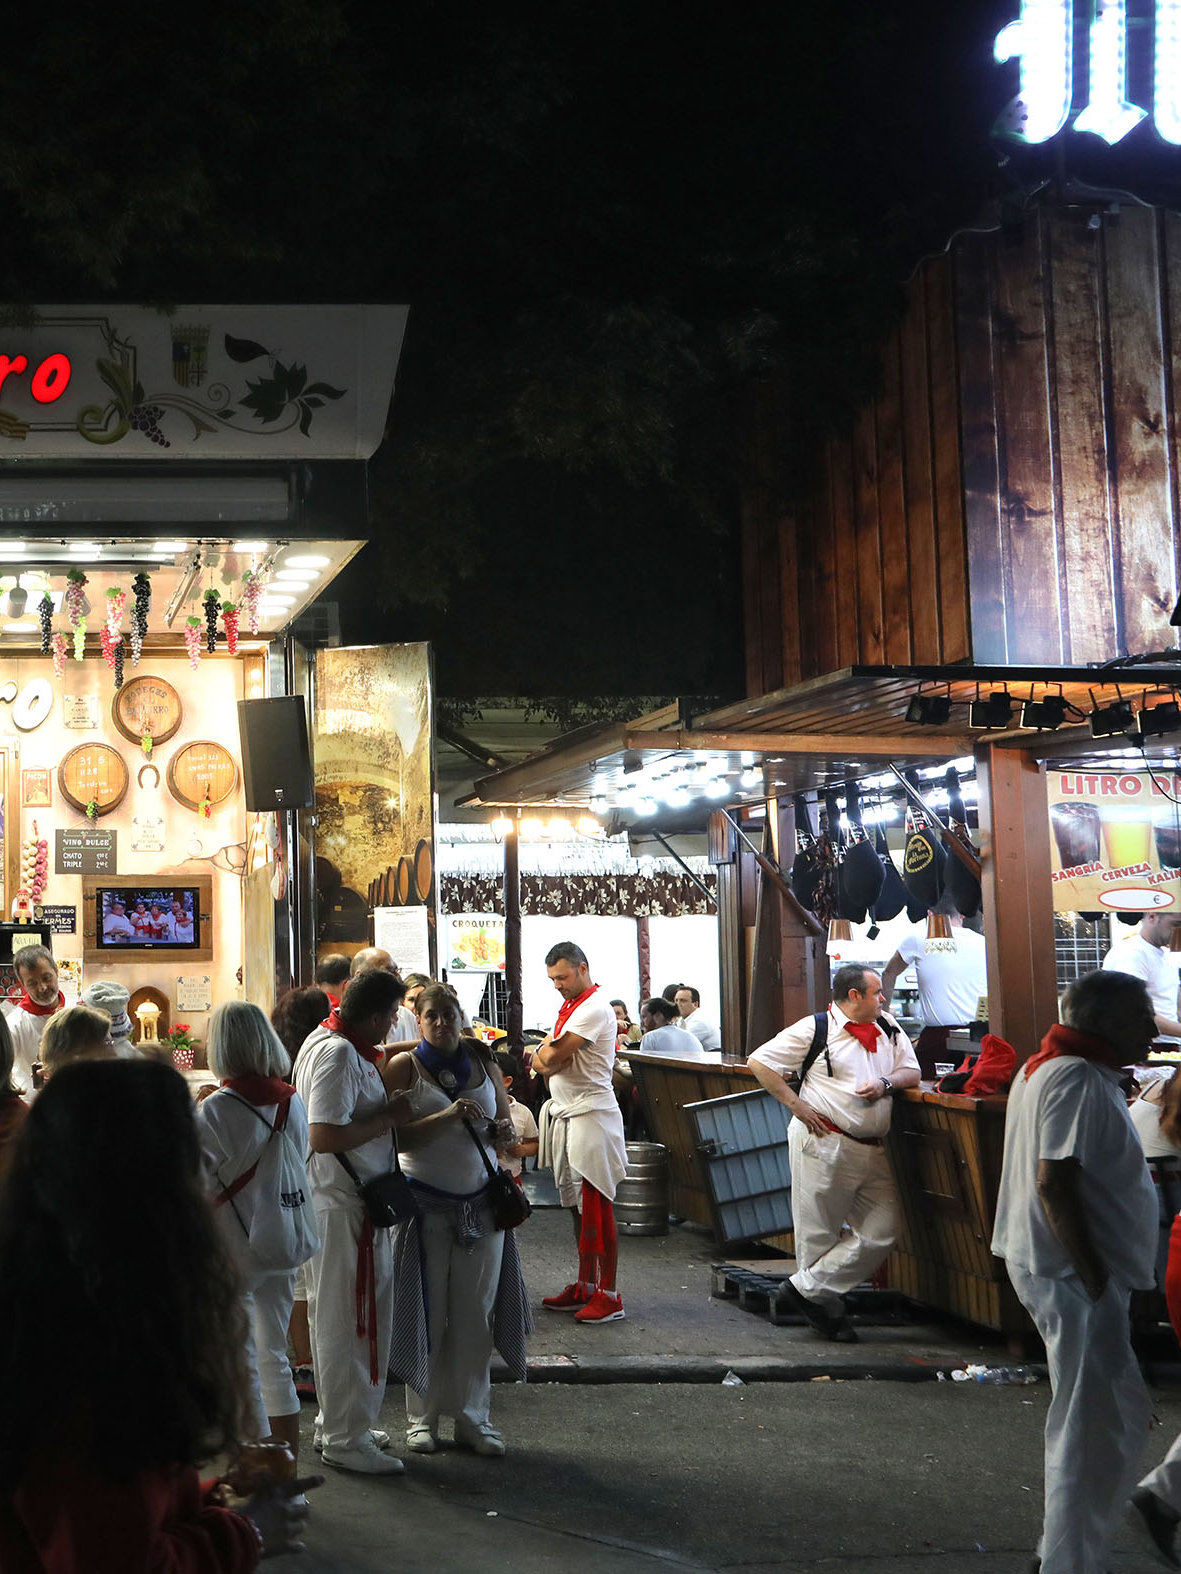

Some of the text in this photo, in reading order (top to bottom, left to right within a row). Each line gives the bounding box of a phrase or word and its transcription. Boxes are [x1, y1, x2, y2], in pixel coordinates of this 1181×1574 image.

[1060, 775, 1142, 795] LITRO
[62, 852, 83, 860] CHATO
[62, 860, 83, 868] TRIPLE
[1101, 862, 1152, 882] CERVEZA
